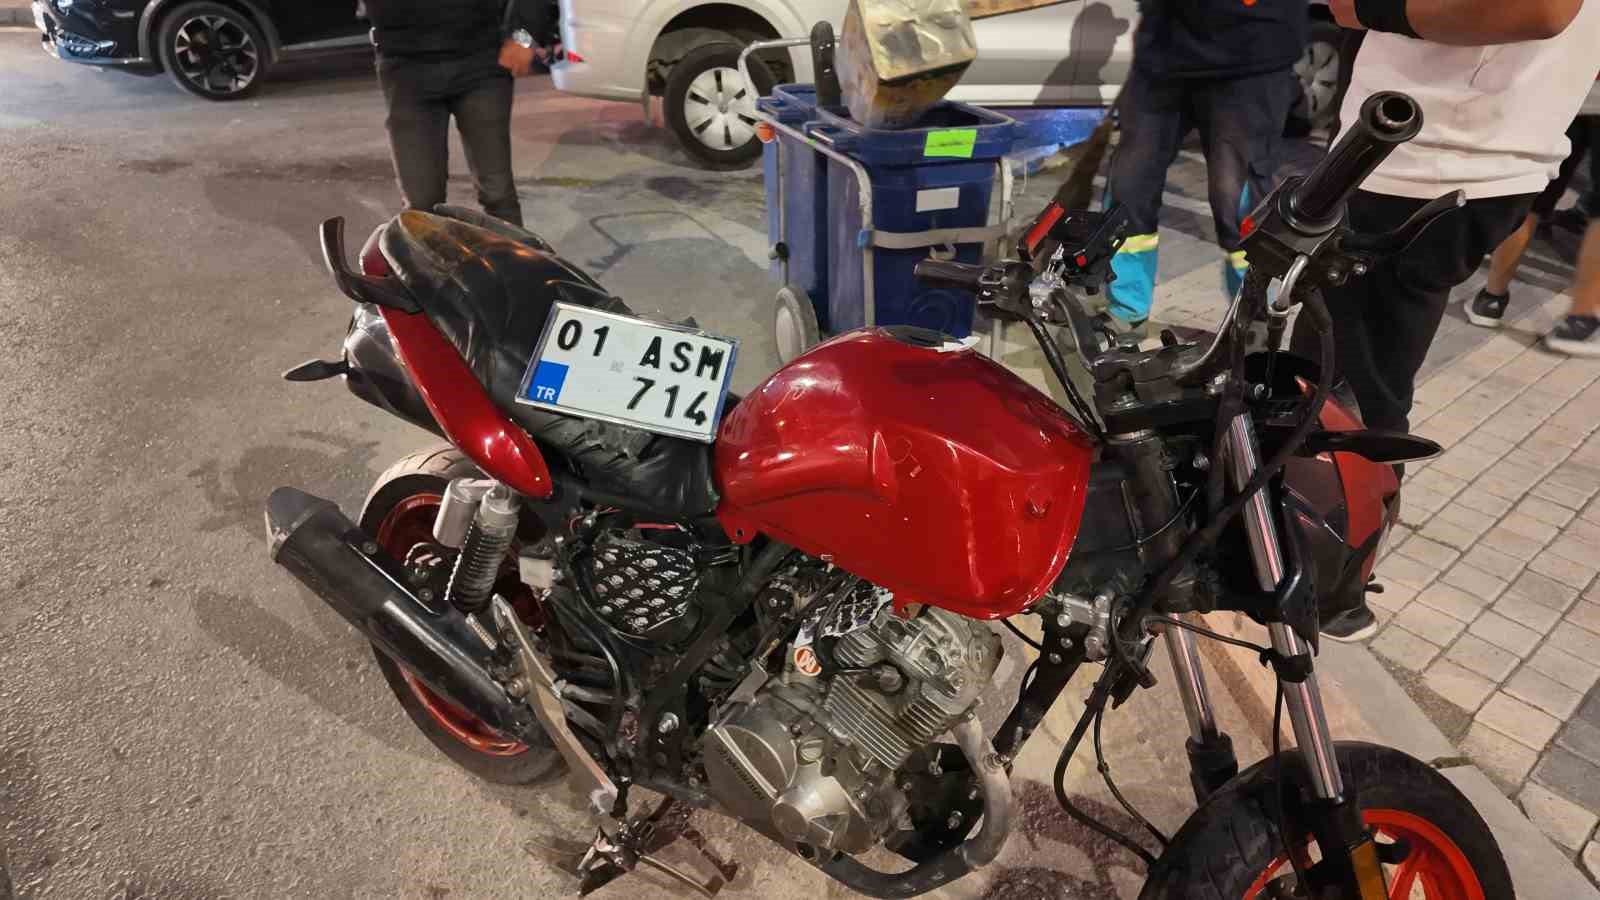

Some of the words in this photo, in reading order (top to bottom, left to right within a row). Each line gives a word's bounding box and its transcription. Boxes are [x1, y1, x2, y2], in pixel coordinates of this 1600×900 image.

[557, 319, 610, 357] 01
[639, 336, 725, 380] ASM
[536, 385, 556, 400] TR
[627, 376, 708, 426] 714
